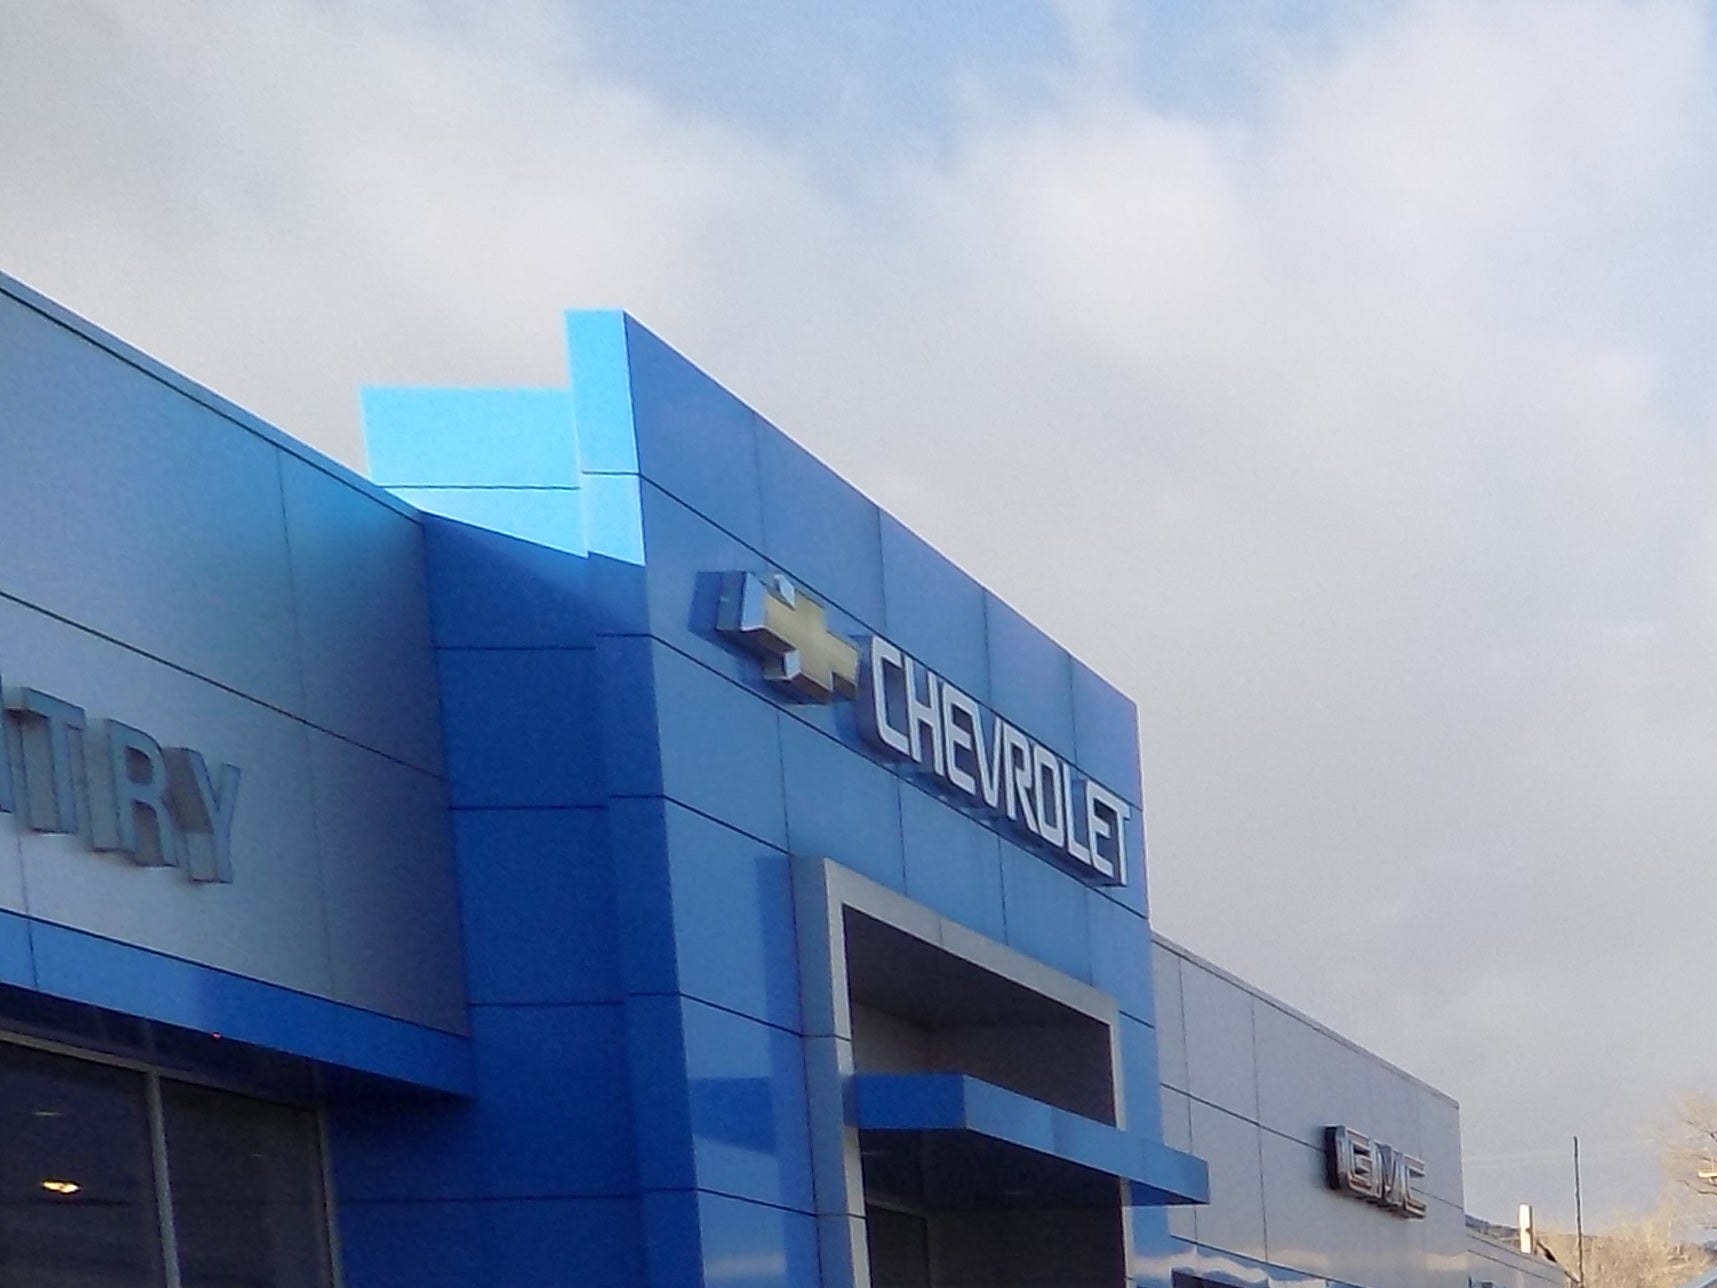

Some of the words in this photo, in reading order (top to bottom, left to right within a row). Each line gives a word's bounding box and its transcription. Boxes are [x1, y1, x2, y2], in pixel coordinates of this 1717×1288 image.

[0, 674, 241, 884] TRY
[871, 634, 1130, 887] CHEVROLET
[1324, 1125, 1427, 1218] GMC
